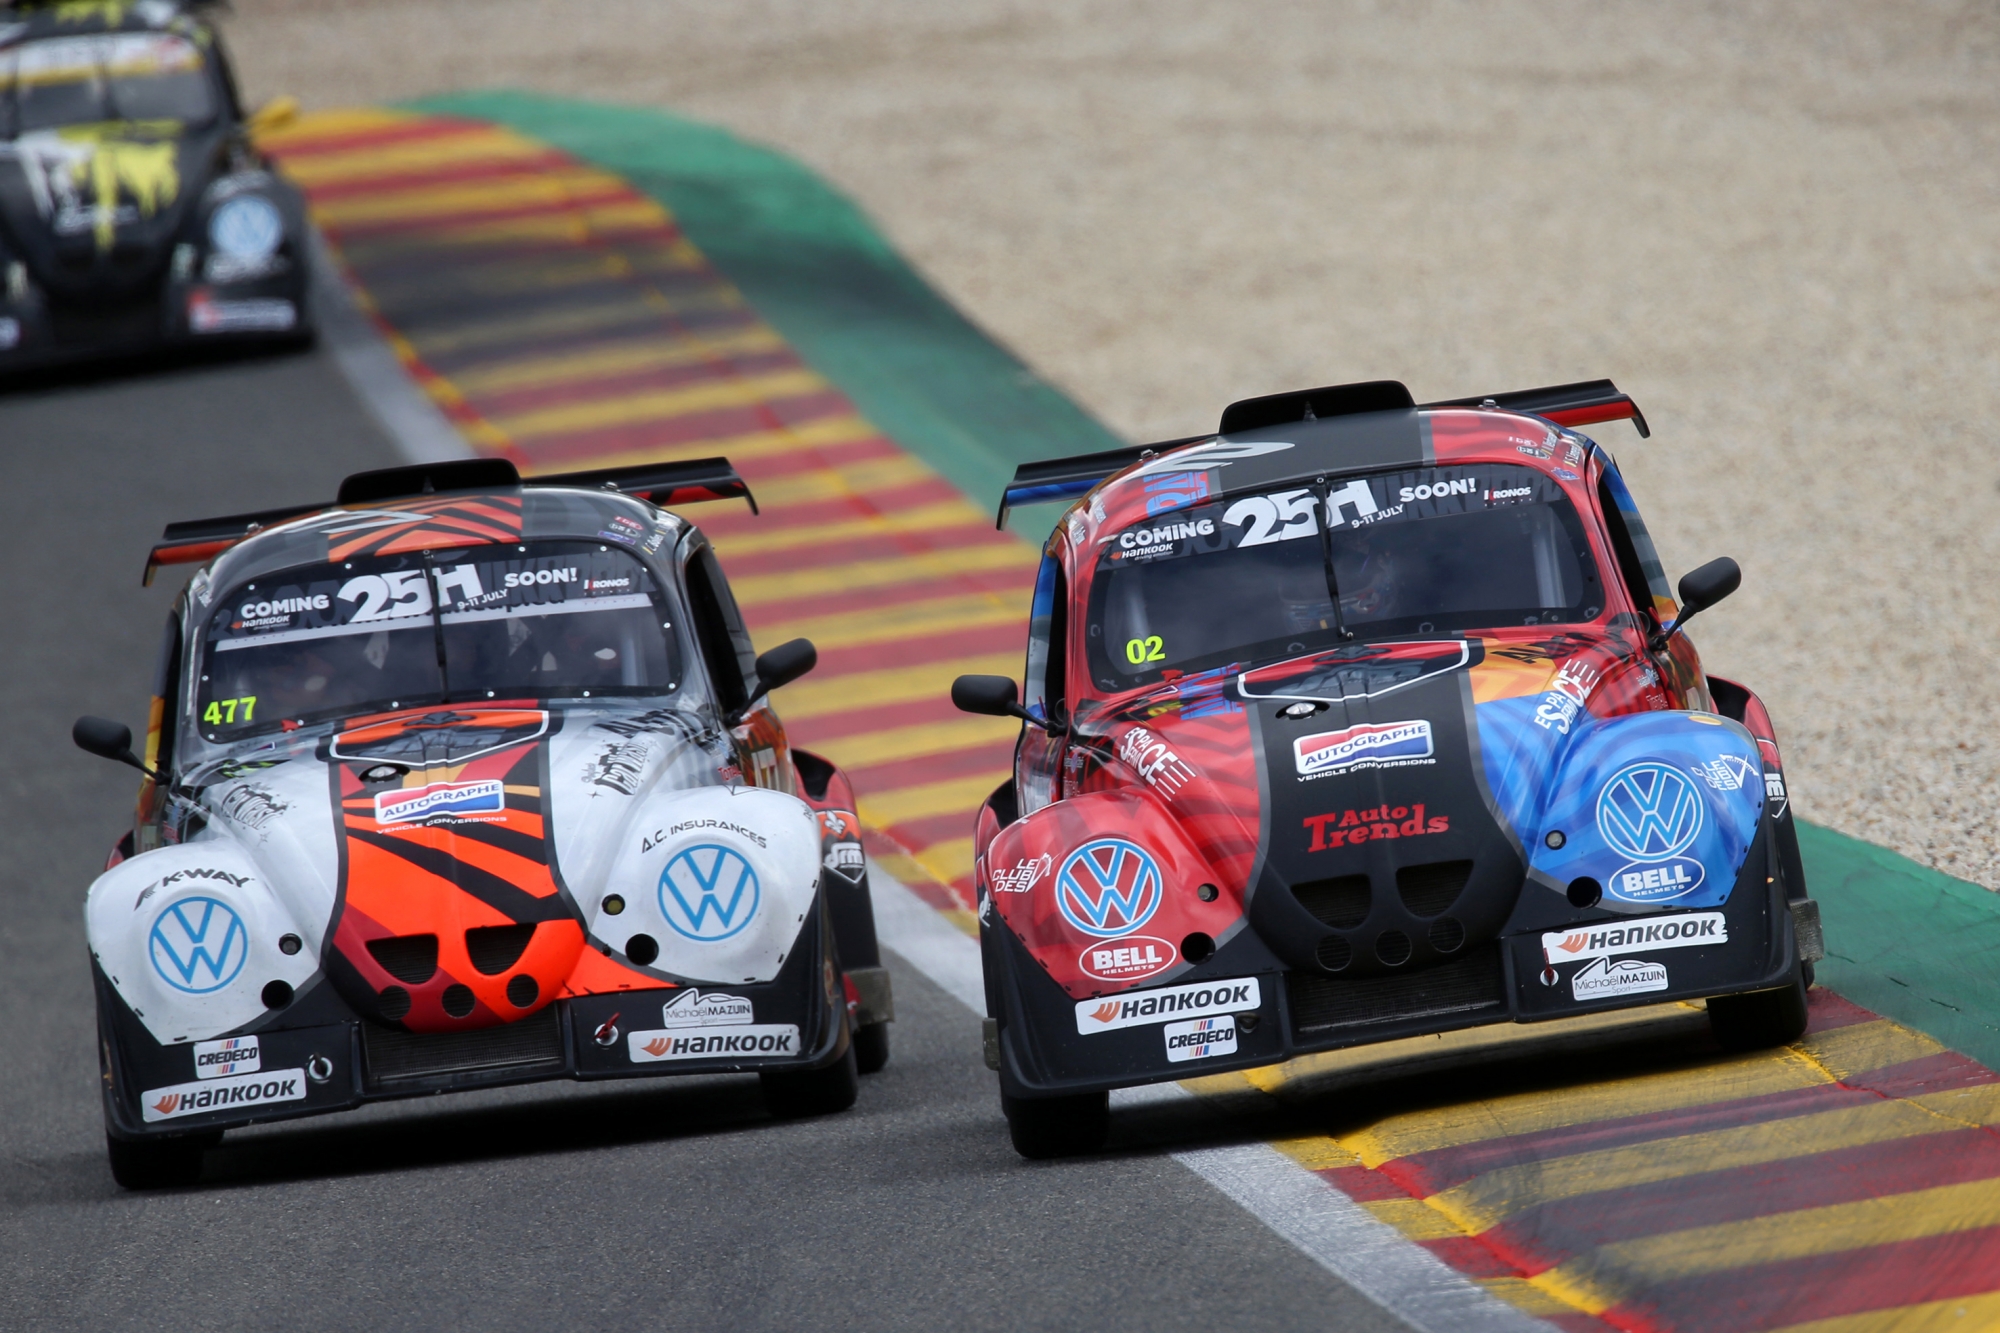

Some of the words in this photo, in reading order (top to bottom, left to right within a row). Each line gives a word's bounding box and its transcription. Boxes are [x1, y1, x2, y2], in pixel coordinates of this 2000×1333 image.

[1483, 486, 1532, 501] KRONOS
[1119, 519, 1215, 549] COMING
[1399, 477, 1477, 503] SOON!
[1351, 514, 1375, 529] 9-11
[1376, 503, 1405, 521] JULY
[240, 593, 330, 619] COMING
[504, 567, 578, 588] SOON!
[583, 577, 631, 591] KRONOS
[456, 597, 479, 610] 9-11
[481, 588, 509, 603] JULY
[1126, 635, 1166, 665] 02
[203, 695, 257, 726] 477
[1303, 724, 1428, 767] AUTOGRAPHE
[1296, 768, 1347, 783] VEHICLE
[1349, 758, 1437, 773] CONVERSIONS
[383, 782, 501, 819] AUTOGRAPHE
[375, 822, 423, 835] VEHICLE
[425, 816, 507, 827] CONVERSIONS
[1302, 803, 1450, 853] Trends
[1338, 804, 1409, 828] Auto
[642, 829, 668, 854] A.C.
[670, 819, 767, 849] INSURANCES
[992, 868, 1033, 882] CLUB
[1016, 858, 1039, 870] LE
[162, 867, 251, 888] K-WAY
[995, 880, 1028, 893] DES
[1621, 864, 1692, 893] BELL
[1633, 884, 1685, 897] HELMETS
[1092, 944, 1163, 971] BELL
[1102, 964, 1156, 976] HELMETS
[1168, 1027, 1235, 1050] CREDECO
[197, 1046, 259, 1067] CREDECO
